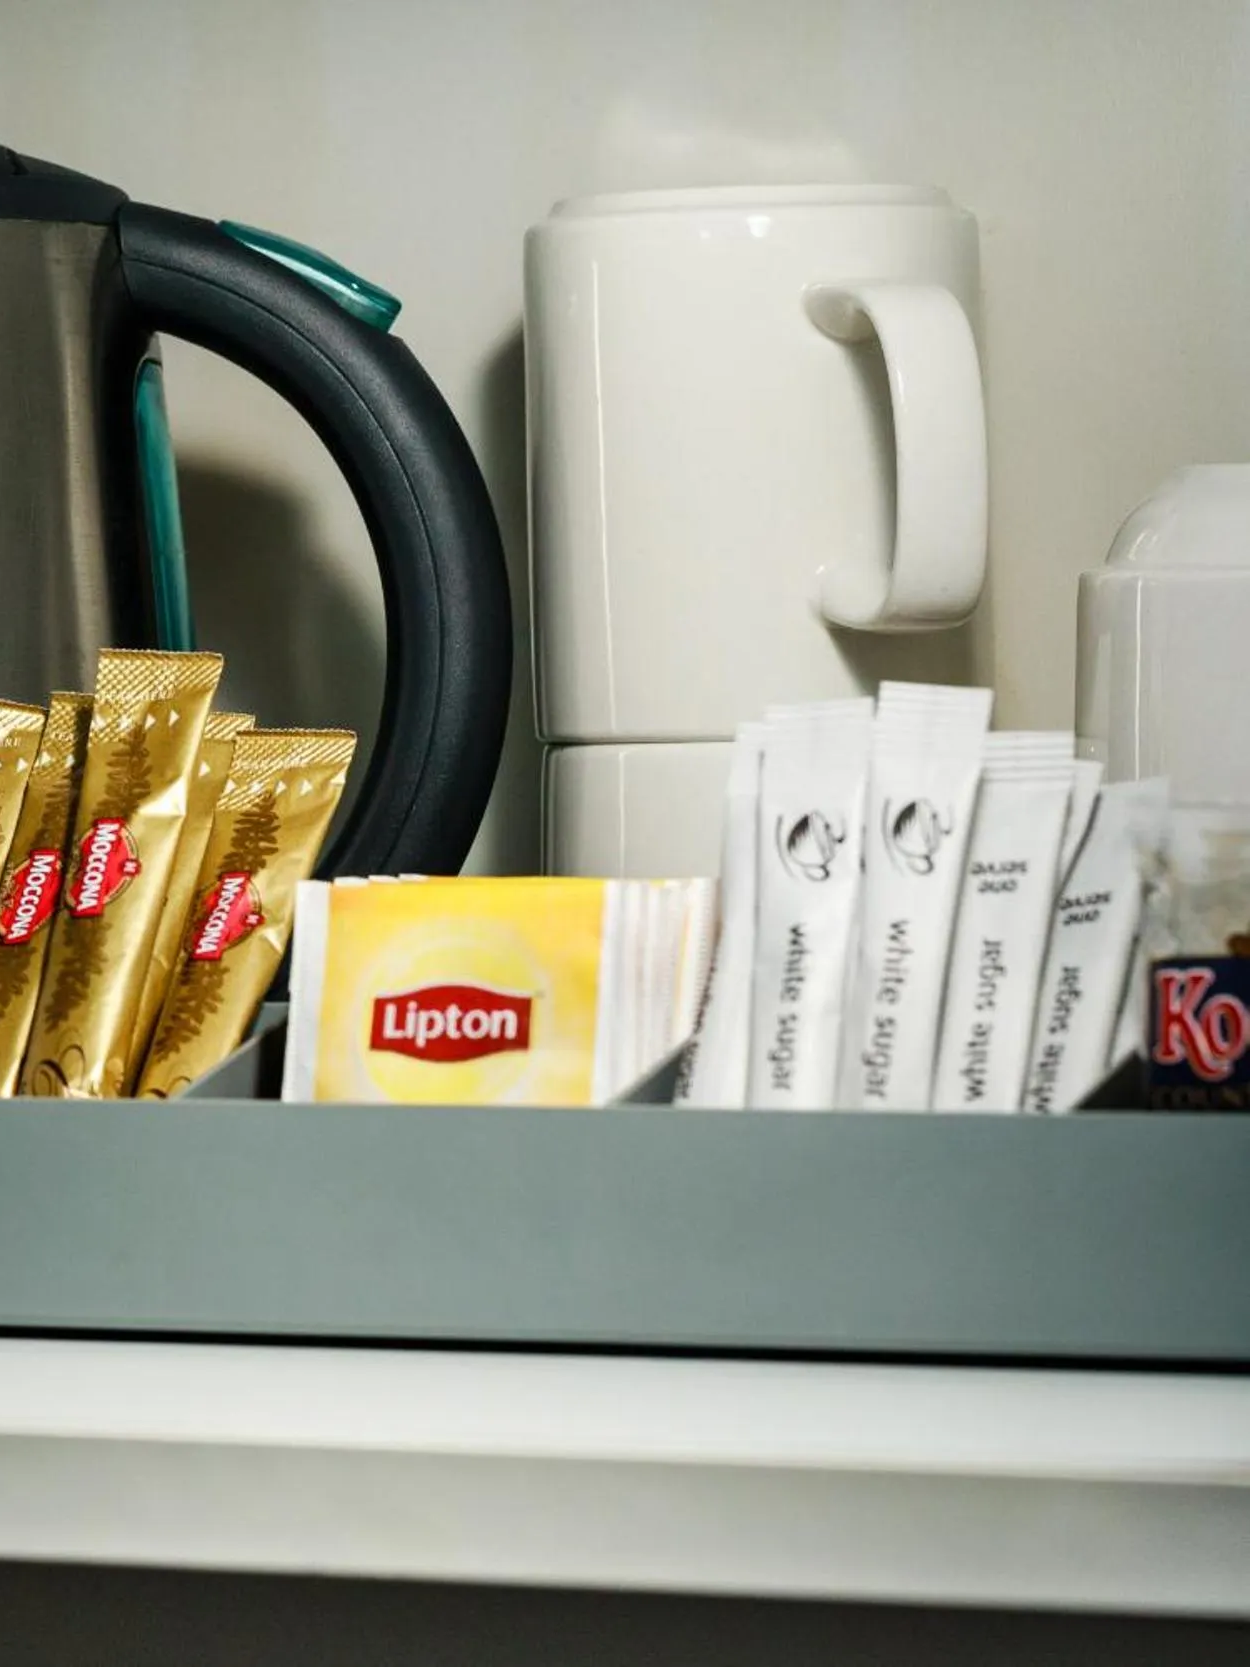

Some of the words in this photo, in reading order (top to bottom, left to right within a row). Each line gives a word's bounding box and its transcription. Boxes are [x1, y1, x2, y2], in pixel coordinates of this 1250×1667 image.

[7, 854, 56, 939] MOCCONA
[77, 823, 120, 912] MOCCONA
[195, 876, 246, 955] MOCCONA
[779, 922, 813, 1004] white
[875, 918, 915, 1005] white
[974, 936, 1007, 1012] sugar
[1047, 966, 1083, 1035] sugar
[382, 1001, 519, 1049] Lipton
[767, 1013, 798, 1091] sugar
[861, 1015, 897, 1100] sugar
[959, 1021, 993, 1103] white
[1152, 967, 1250, 1082] Ko
